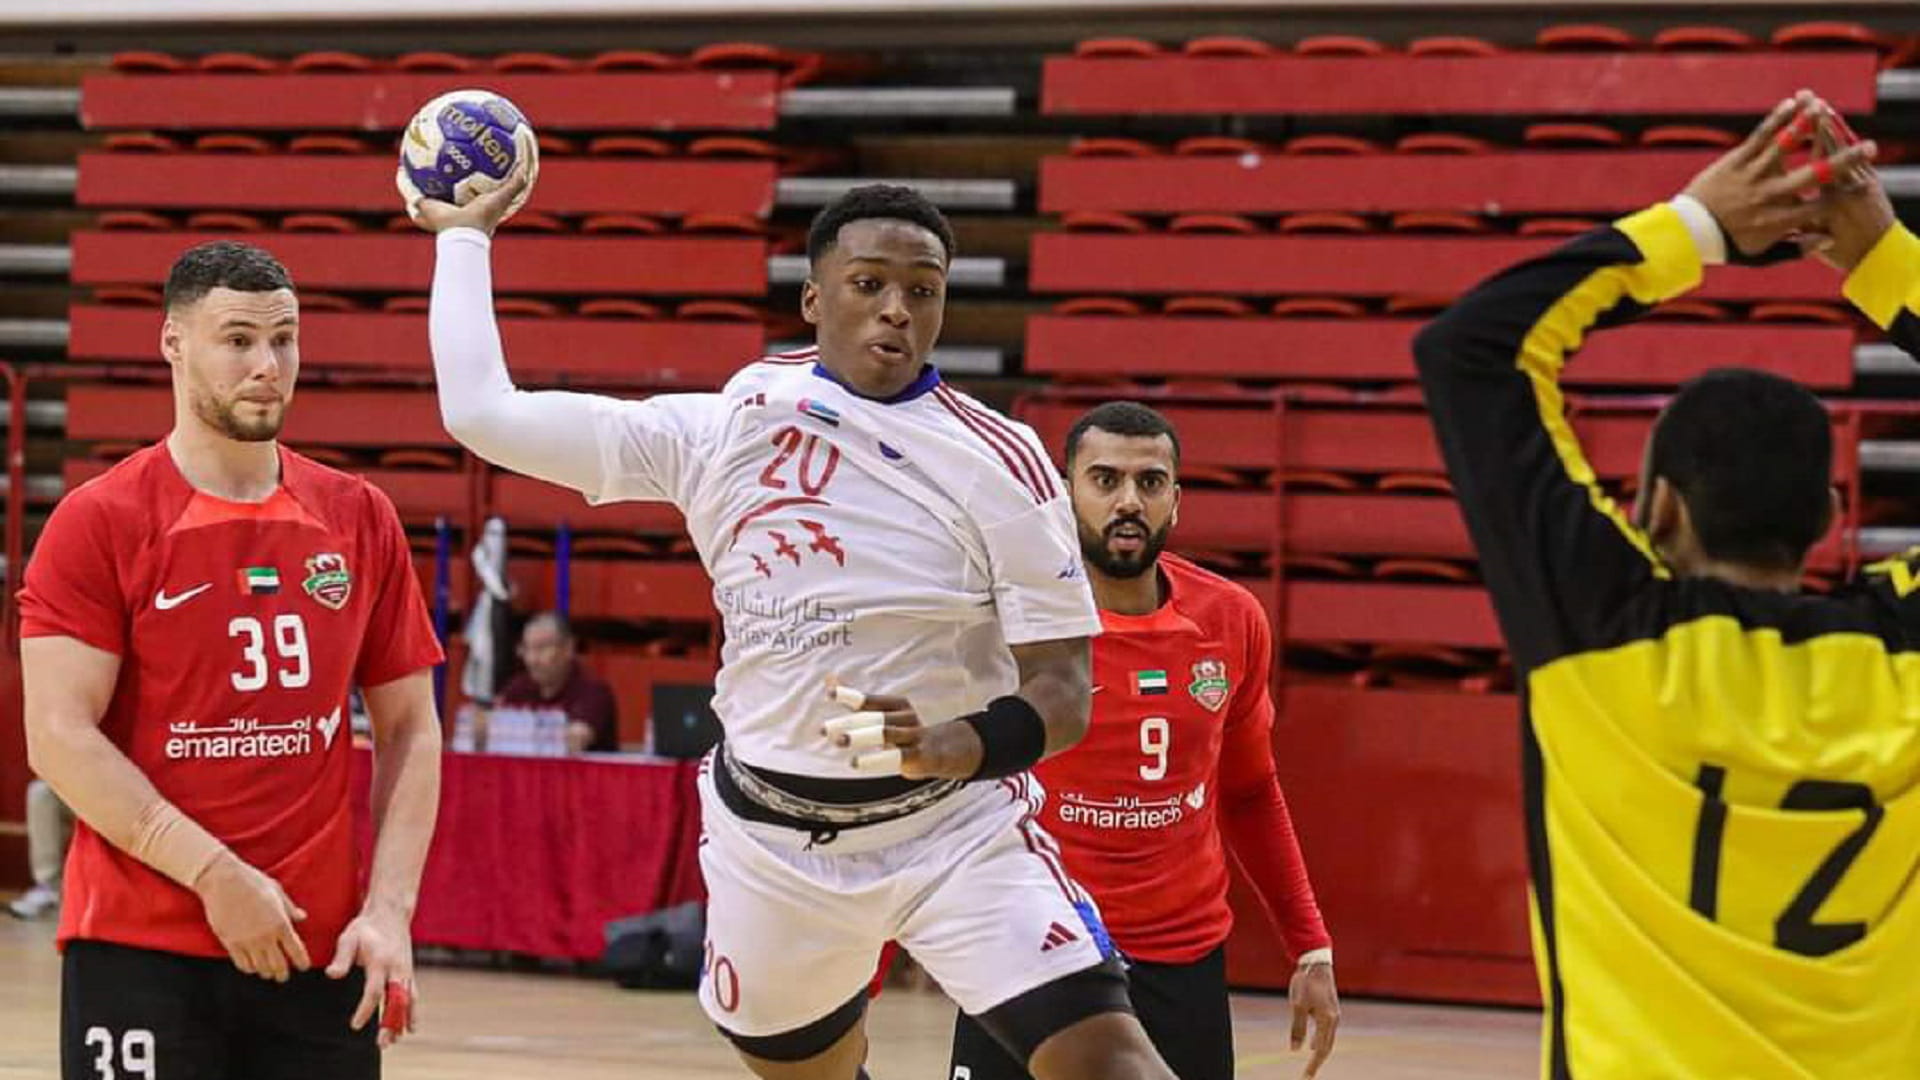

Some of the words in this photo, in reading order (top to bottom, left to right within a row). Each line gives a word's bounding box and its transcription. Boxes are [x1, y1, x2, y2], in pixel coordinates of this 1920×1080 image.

[443, 106, 509, 170] molten
[760, 426, 840, 496] 20
[228, 614, 311, 691] 39
[165, 732, 311, 759] emaratech
[1139, 717, 1170, 781] 9
[1059, 803, 1184, 829] emaratech
[1688, 761, 1884, 957] 12
[85, 1026, 156, 1080] 39
